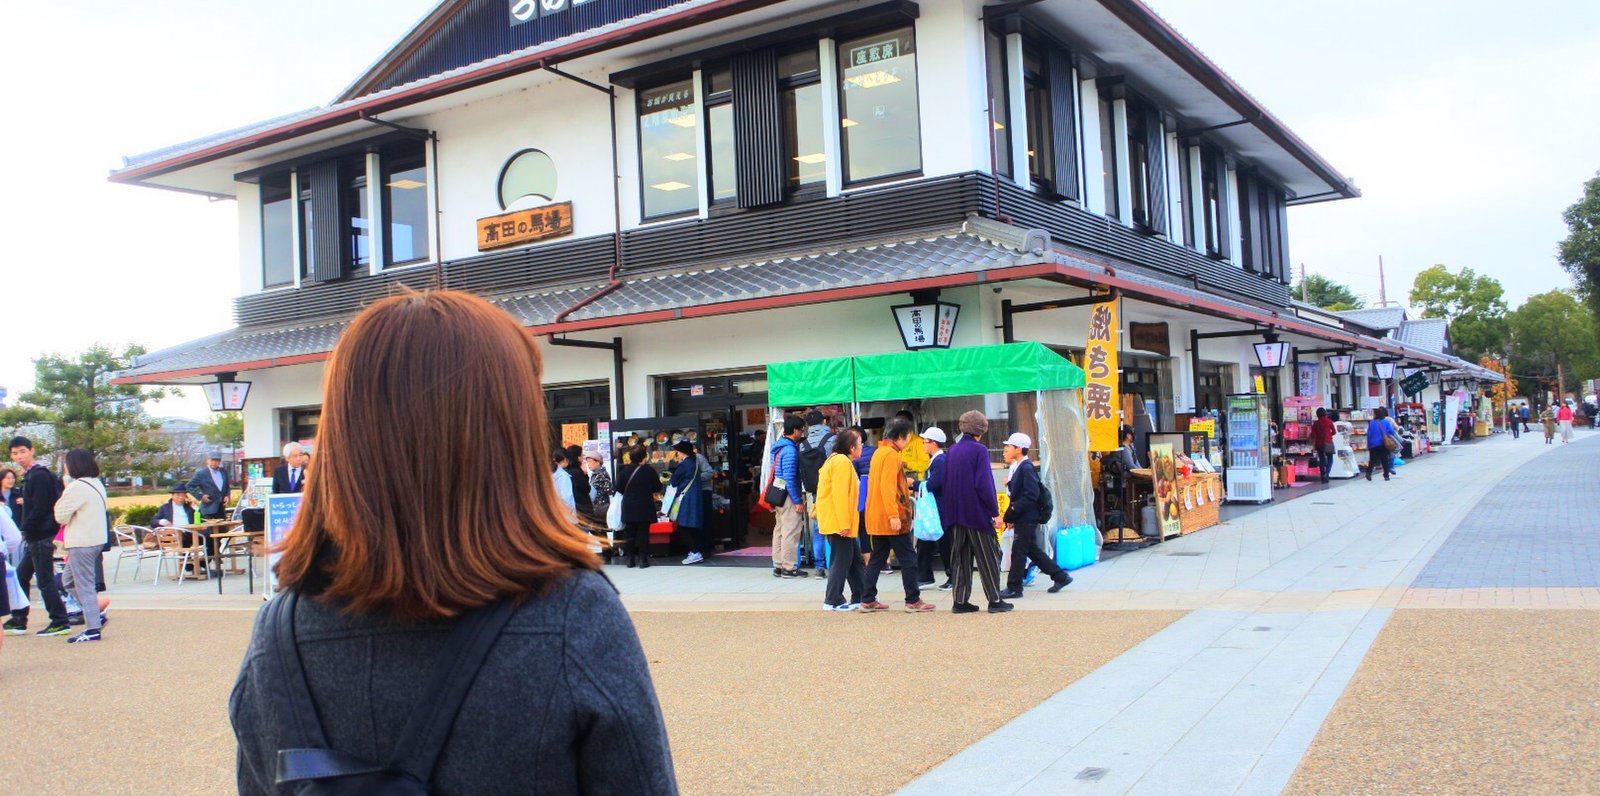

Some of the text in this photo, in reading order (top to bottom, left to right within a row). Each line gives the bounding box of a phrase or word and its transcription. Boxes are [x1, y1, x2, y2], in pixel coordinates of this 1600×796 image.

[484, 209, 562, 243] 高田の馬場
[910, 309, 926, 343] 高田の馬場
